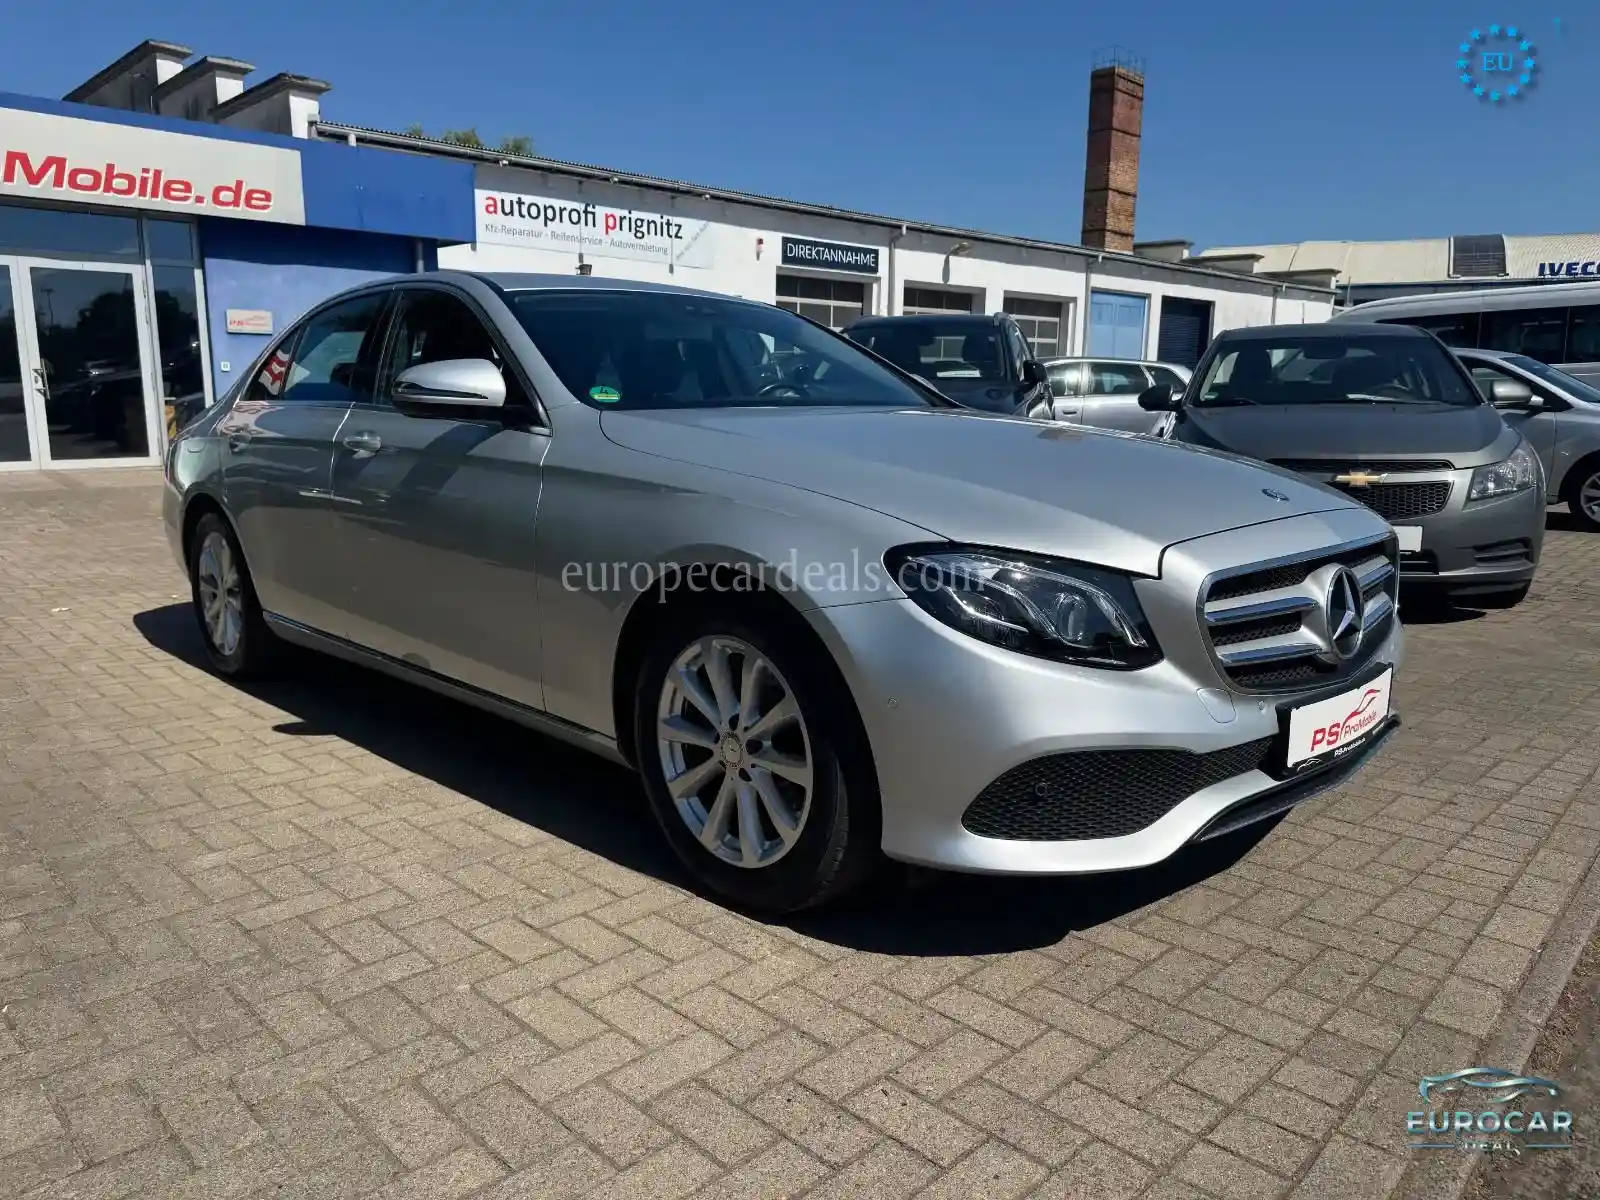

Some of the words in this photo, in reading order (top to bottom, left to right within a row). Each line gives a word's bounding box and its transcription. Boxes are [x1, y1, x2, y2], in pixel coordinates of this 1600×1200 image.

[3, 150, 273, 211] Mobile.de
[485, 196, 596, 228] autoprofi
[604, 210, 683, 240] prignitz
[485, 223, 543, 239] Kfz-Reparatur
[550, 231, 603, 246] Reifenservice
[609, 239, 669, 256] Autovermietung
[786, 243, 877, 267] DIREKTANNAHME
[1310, 722, 1341, 752] PS
